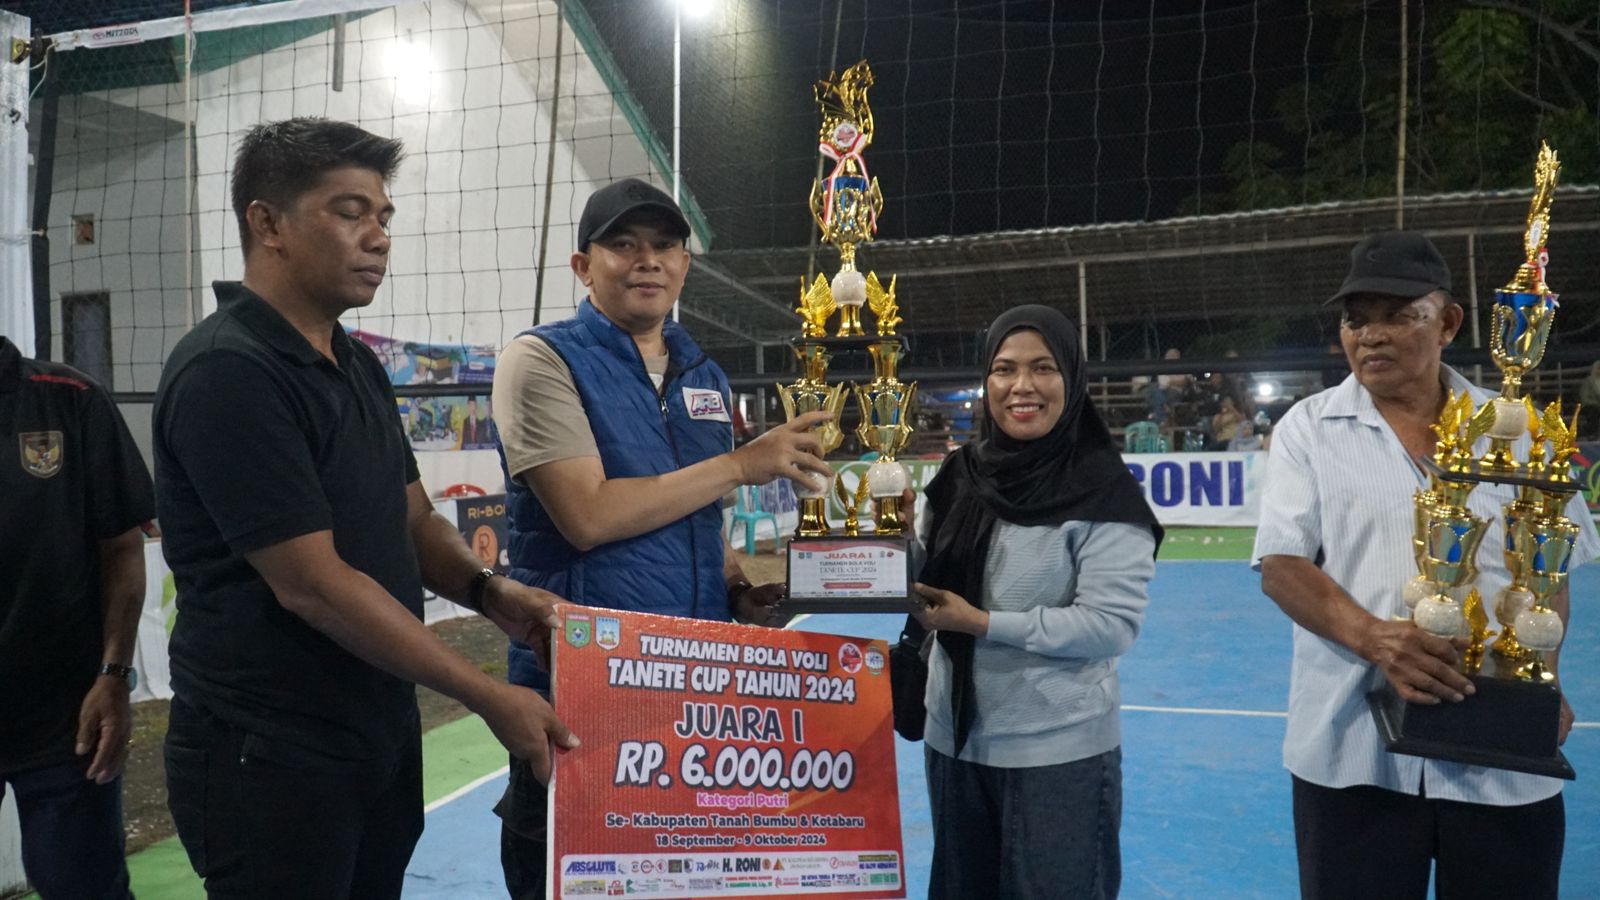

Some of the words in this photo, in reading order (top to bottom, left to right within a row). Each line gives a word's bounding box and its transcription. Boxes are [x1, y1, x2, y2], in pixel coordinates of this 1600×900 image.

[640, 635, 739, 663] TURNAMEN
[743, 646, 787, 666] BOLA
[792, 650, 828, 670] VOLI
[608, 658, 686, 690] TANETE
[691, 666, 730, 693] CUP
[735, 669, 801, 699] TAHUN
[805, 675, 855, 702] 2024
[675, 702, 784, 743] JUARA
[792, 708, 804, 743] I
[614, 742, 671, 787] RP.
[681, 744, 853, 790] 6.000.000
[697, 792, 754, 810] Kategori
[757, 792, 789, 807] Putri
[606, 814, 629, 827] Se-
[632, 814, 708, 829] Kabupaten
[710, 814, 750, 827] Tanah
[753, 815, 797, 828] Bumbu
[799, 815, 808, 828] &
[811, 814, 866, 828] Kotabaru
[656, 835, 669, 846] 18
[671, 835, 735, 848] September
[744, 835, 752, 846] 9
[754, 834, 798, 846] Oktober
[800, 834, 826, 846] 2024
[566, 860, 616, 872] ABSOLUTE
[722, 858, 733, 873] H.
[735, 857, 761, 872] RONI
